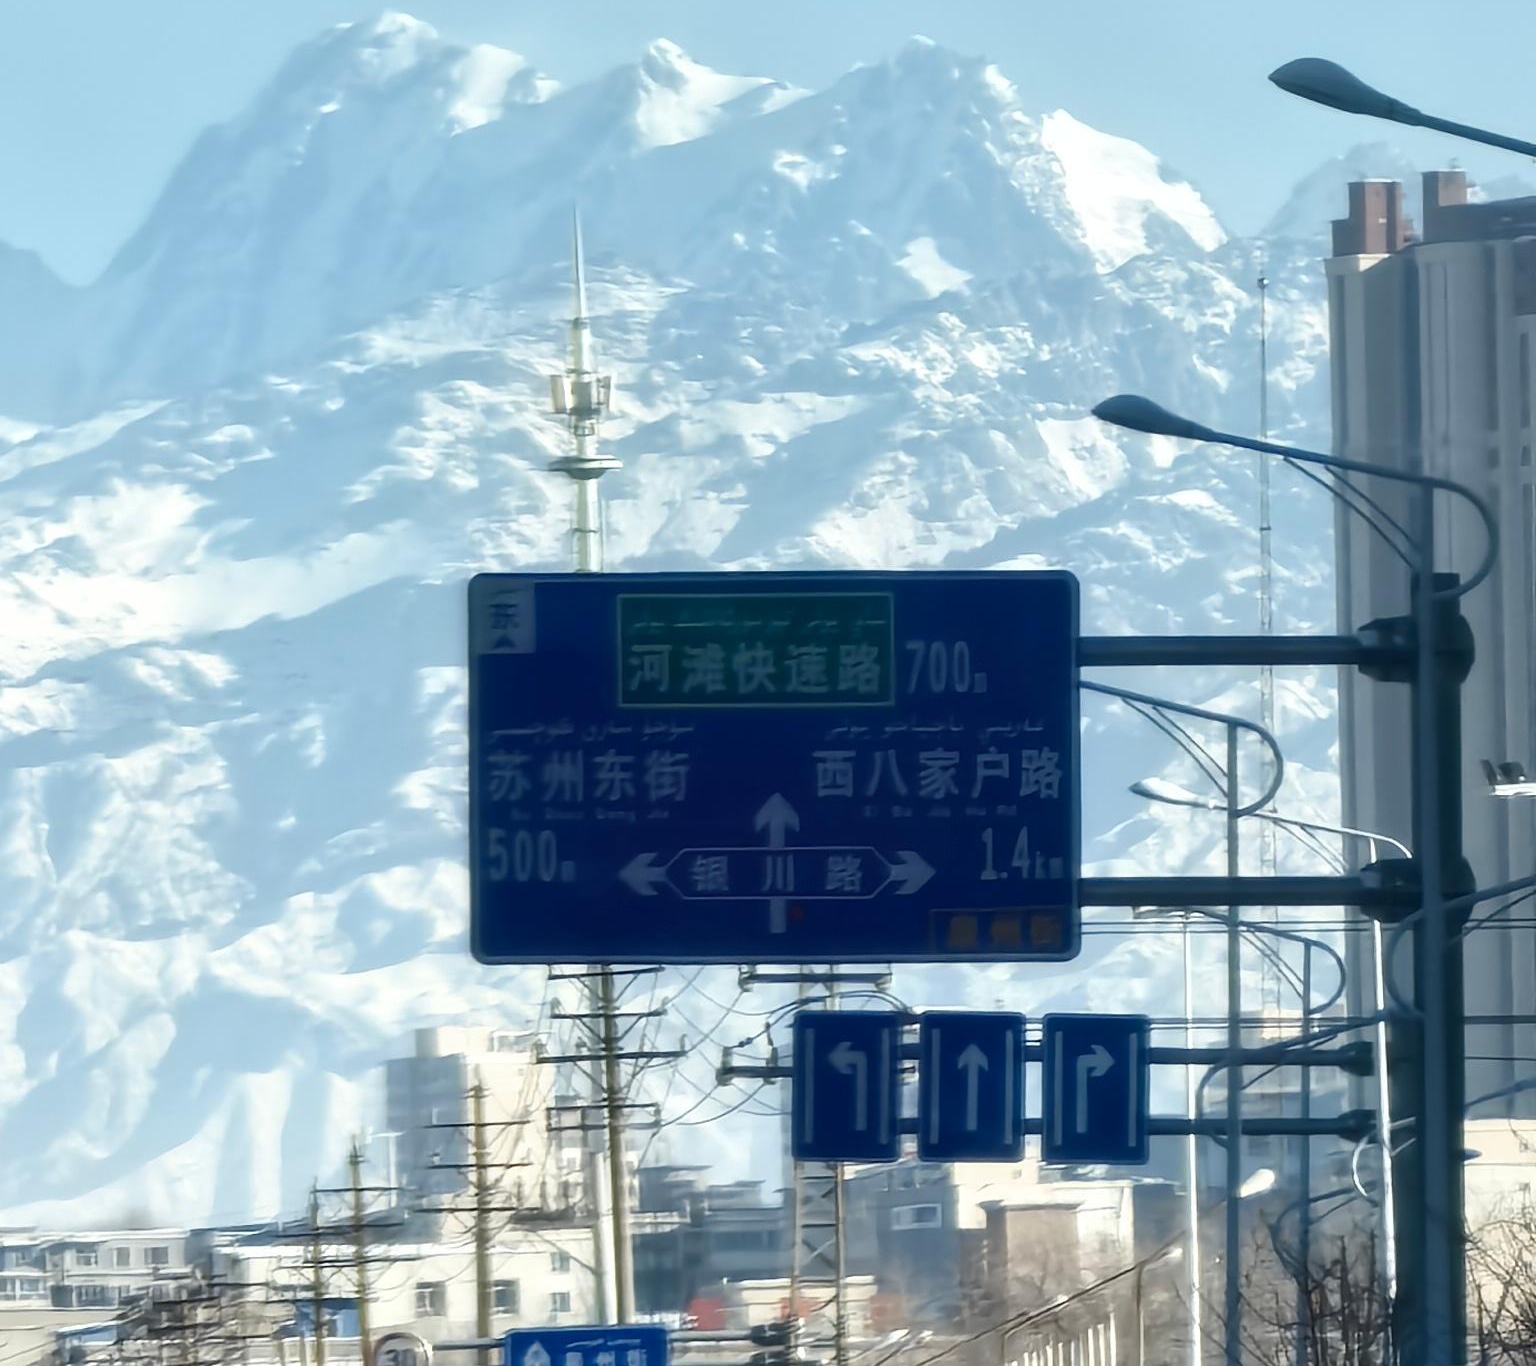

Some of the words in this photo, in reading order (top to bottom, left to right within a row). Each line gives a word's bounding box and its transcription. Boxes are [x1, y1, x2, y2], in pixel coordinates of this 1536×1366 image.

[628, 642, 882, 694] 河滩快速路
[487, 749, 689, 802] 苏州东街
[812, 746, 1063, 800] 西八家户路
[689, 854, 863, 892] 银川路
